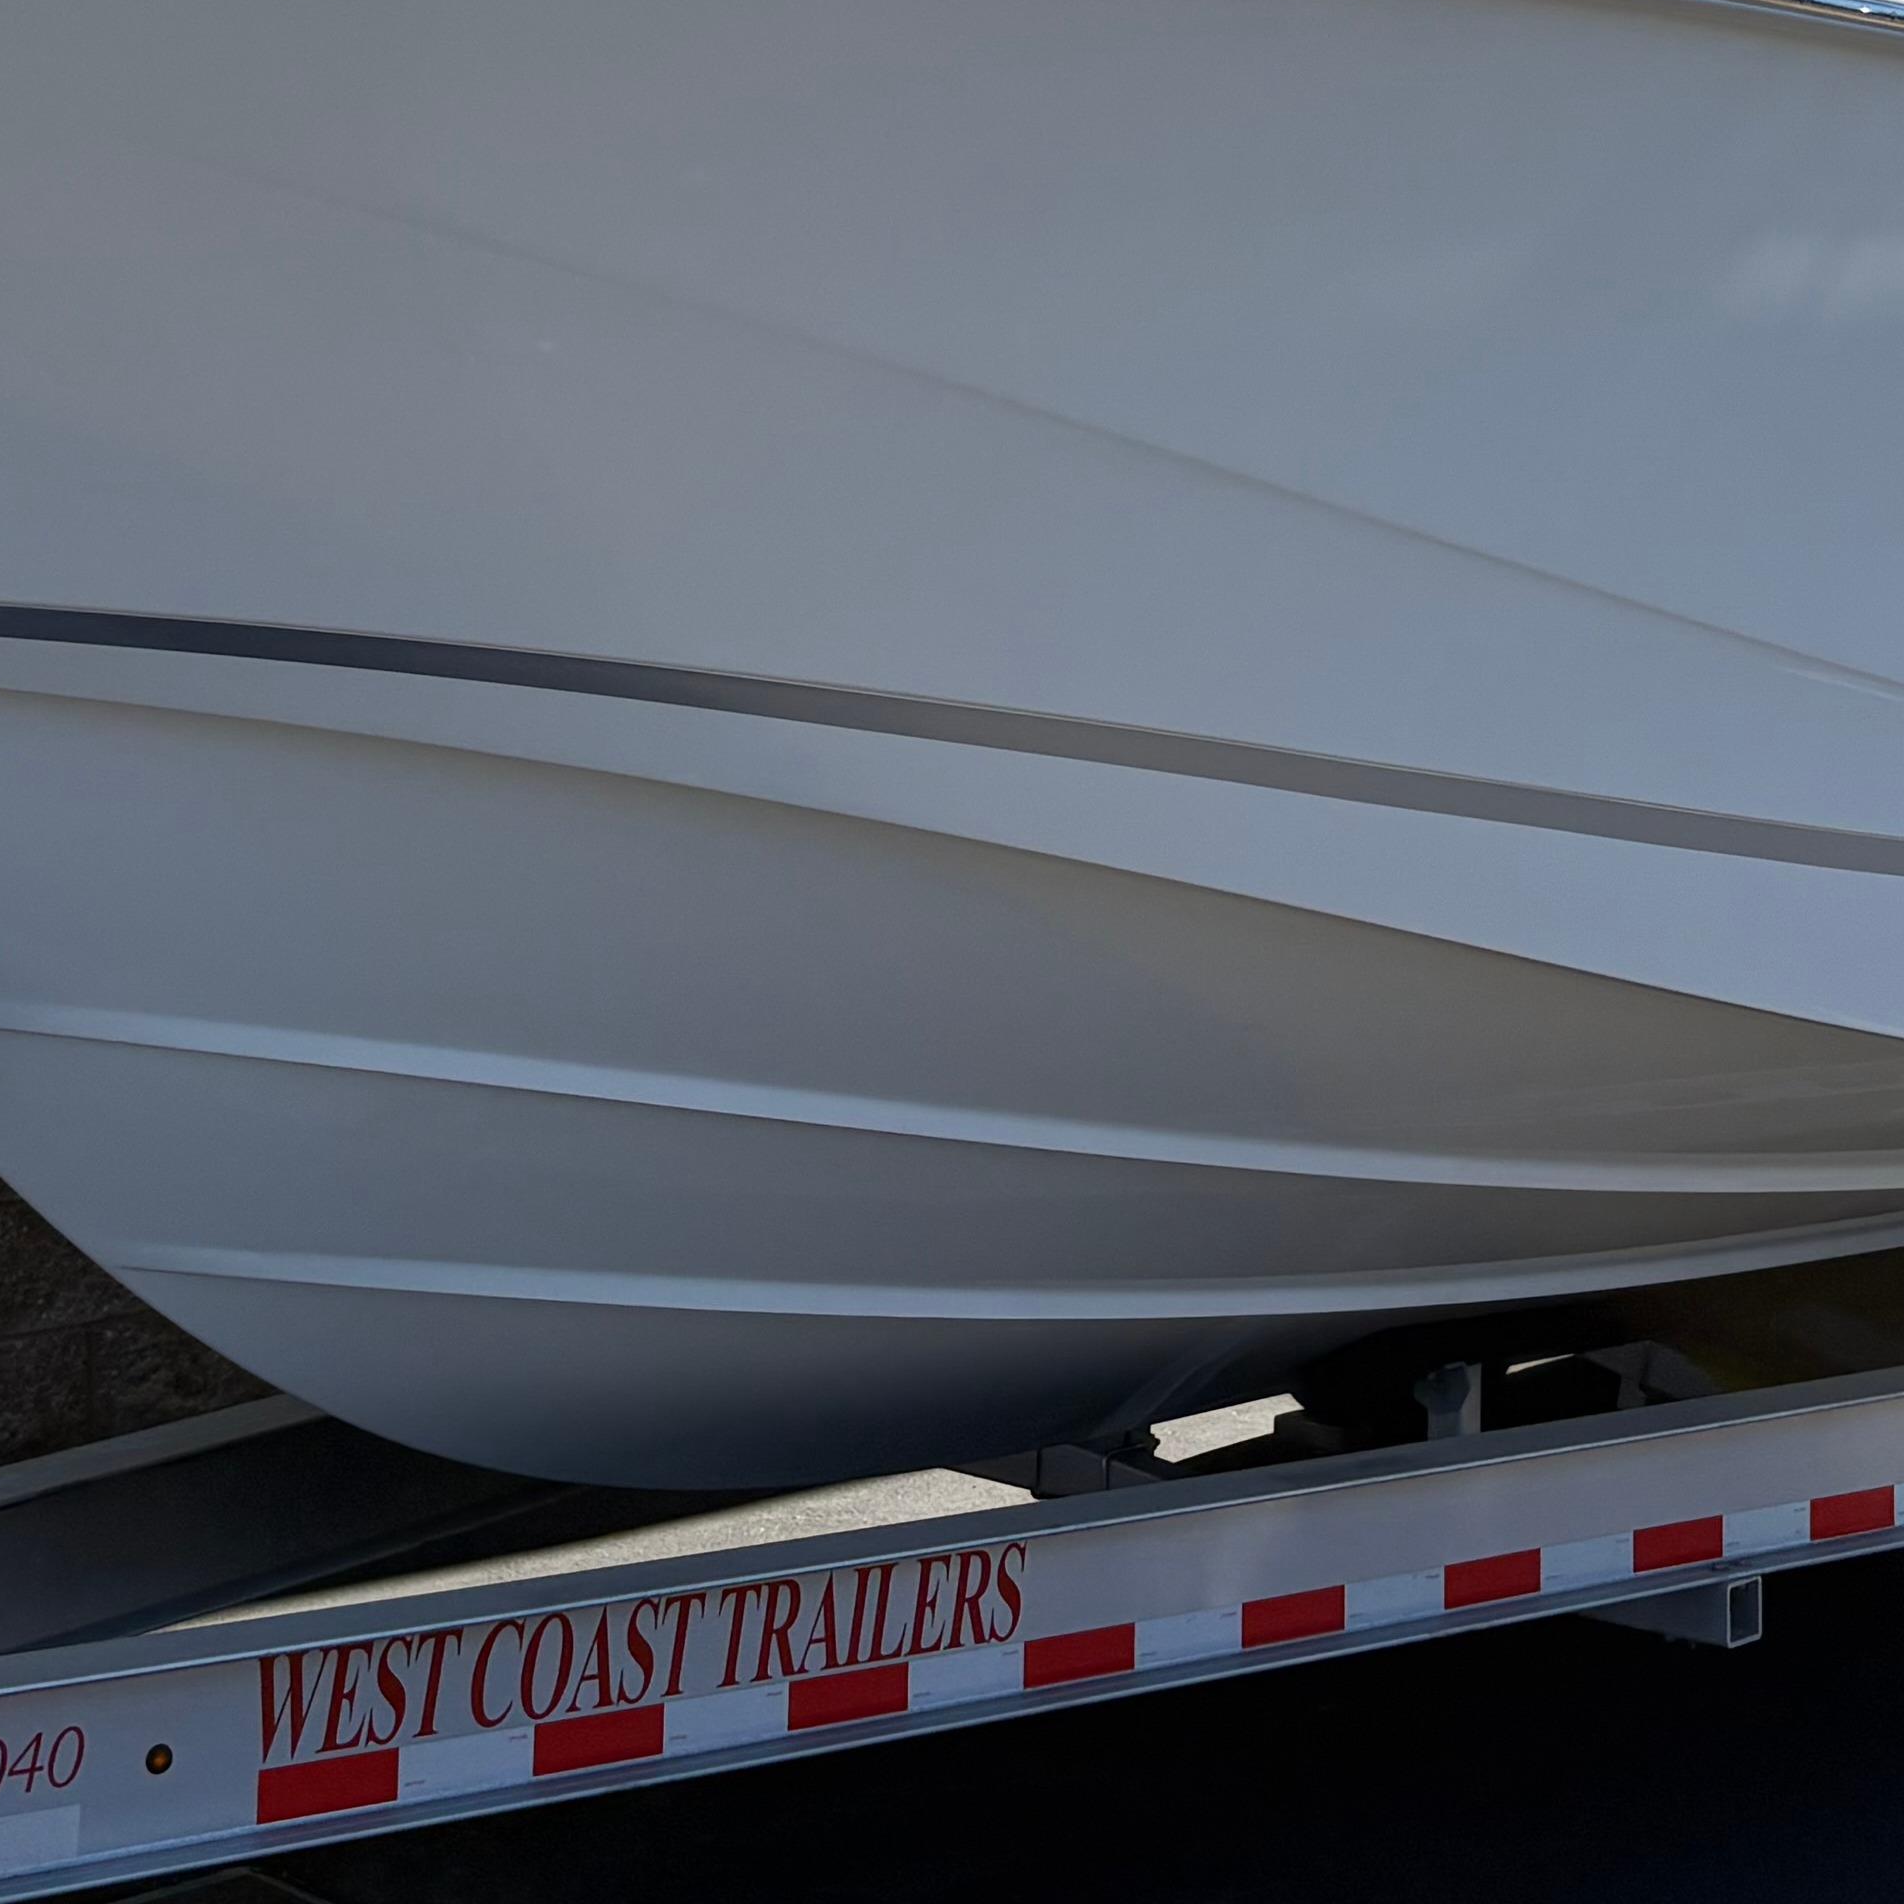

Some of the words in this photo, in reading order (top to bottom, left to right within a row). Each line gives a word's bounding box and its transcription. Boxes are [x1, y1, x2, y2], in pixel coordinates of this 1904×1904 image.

[258, 1628, 464, 1764] WEST
[470, 1592, 707, 1729] COAST
[716, 1542, 1028, 1689] TRAILERS
